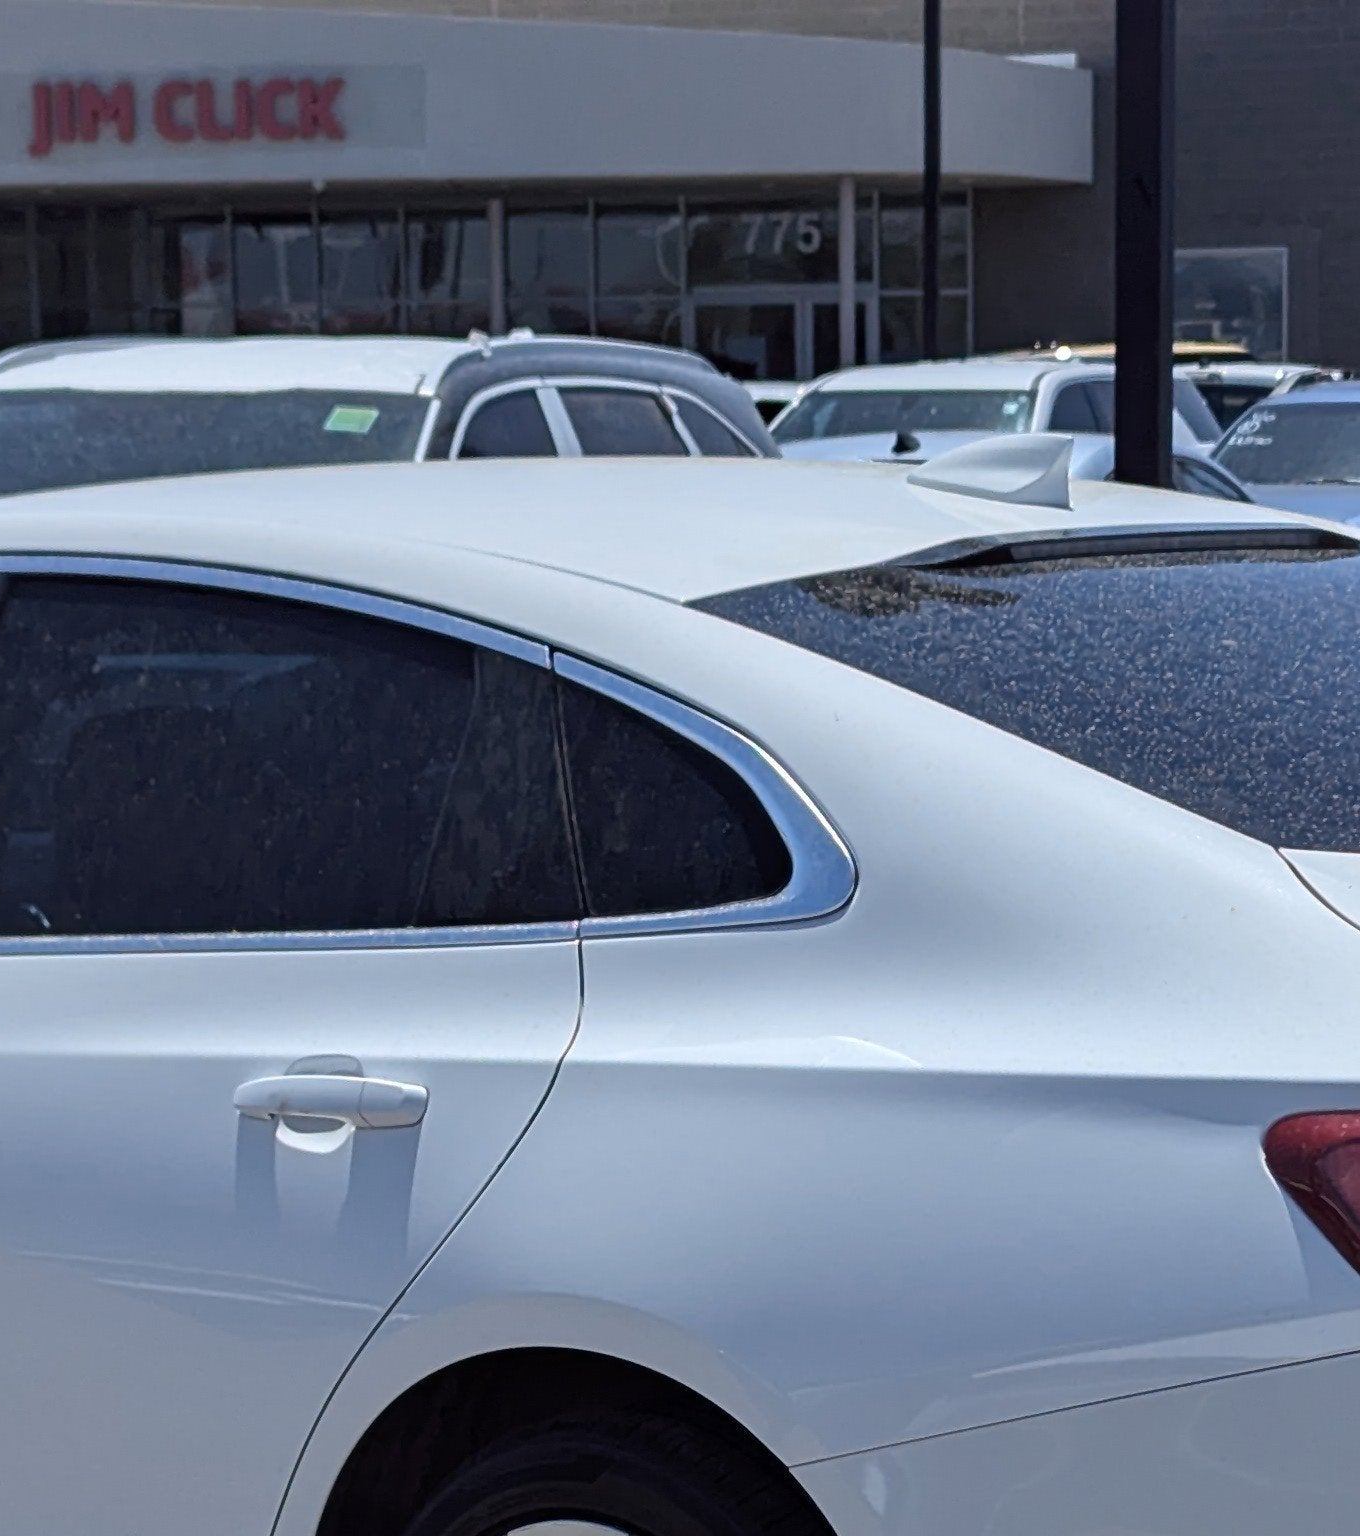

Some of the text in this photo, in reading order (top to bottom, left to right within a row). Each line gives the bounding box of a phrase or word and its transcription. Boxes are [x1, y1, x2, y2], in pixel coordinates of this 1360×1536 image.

[28, 76, 347, 158] JIM CLICK
[740, 211, 822, 254] 775
